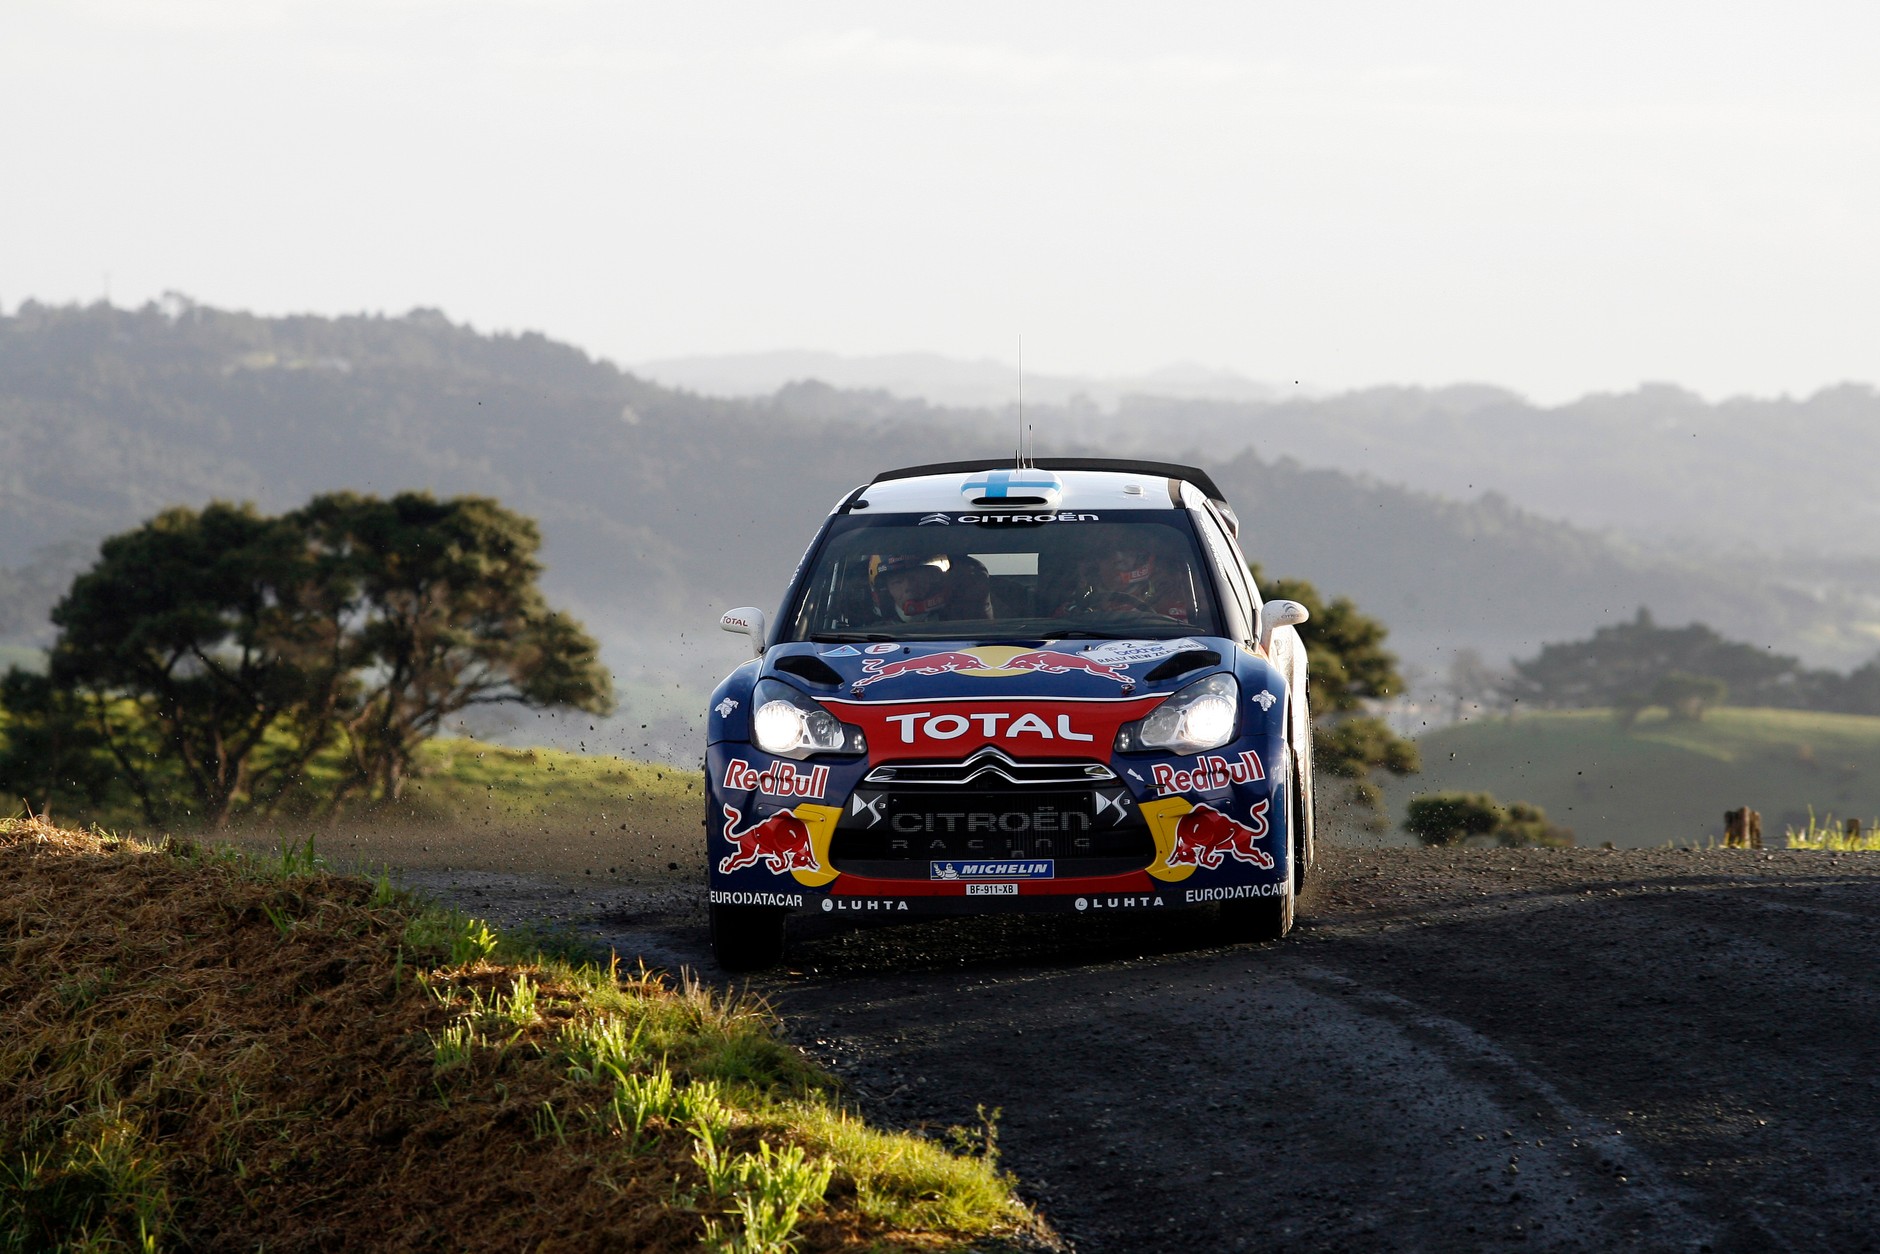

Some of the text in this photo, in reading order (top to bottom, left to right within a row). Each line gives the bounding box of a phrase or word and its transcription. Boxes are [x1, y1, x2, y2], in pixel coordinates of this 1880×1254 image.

[958, 512, 1099, 524] CITROËN
[723, 616, 748, 627] TOTAL
[1114, 646, 1166, 656] brother
[1097, 656, 1127, 664] RALLY
[1129, 653, 1153, 661] NEW
[886, 711, 1094, 743] TOTAL
[890, 806, 1091, 833] CITROËN
[891, 838, 1091, 849] RACING
[961, 863, 1048, 875] MICHELIN
[969, 884, 1014, 895] BF-911-XB
[1186, 881, 1288, 903] EURODATACAR
[710, 890, 803, 907] EURODATACAR
[1093, 896, 1164, 908] LUHTA
[838, 900, 909, 910] LUHTA
